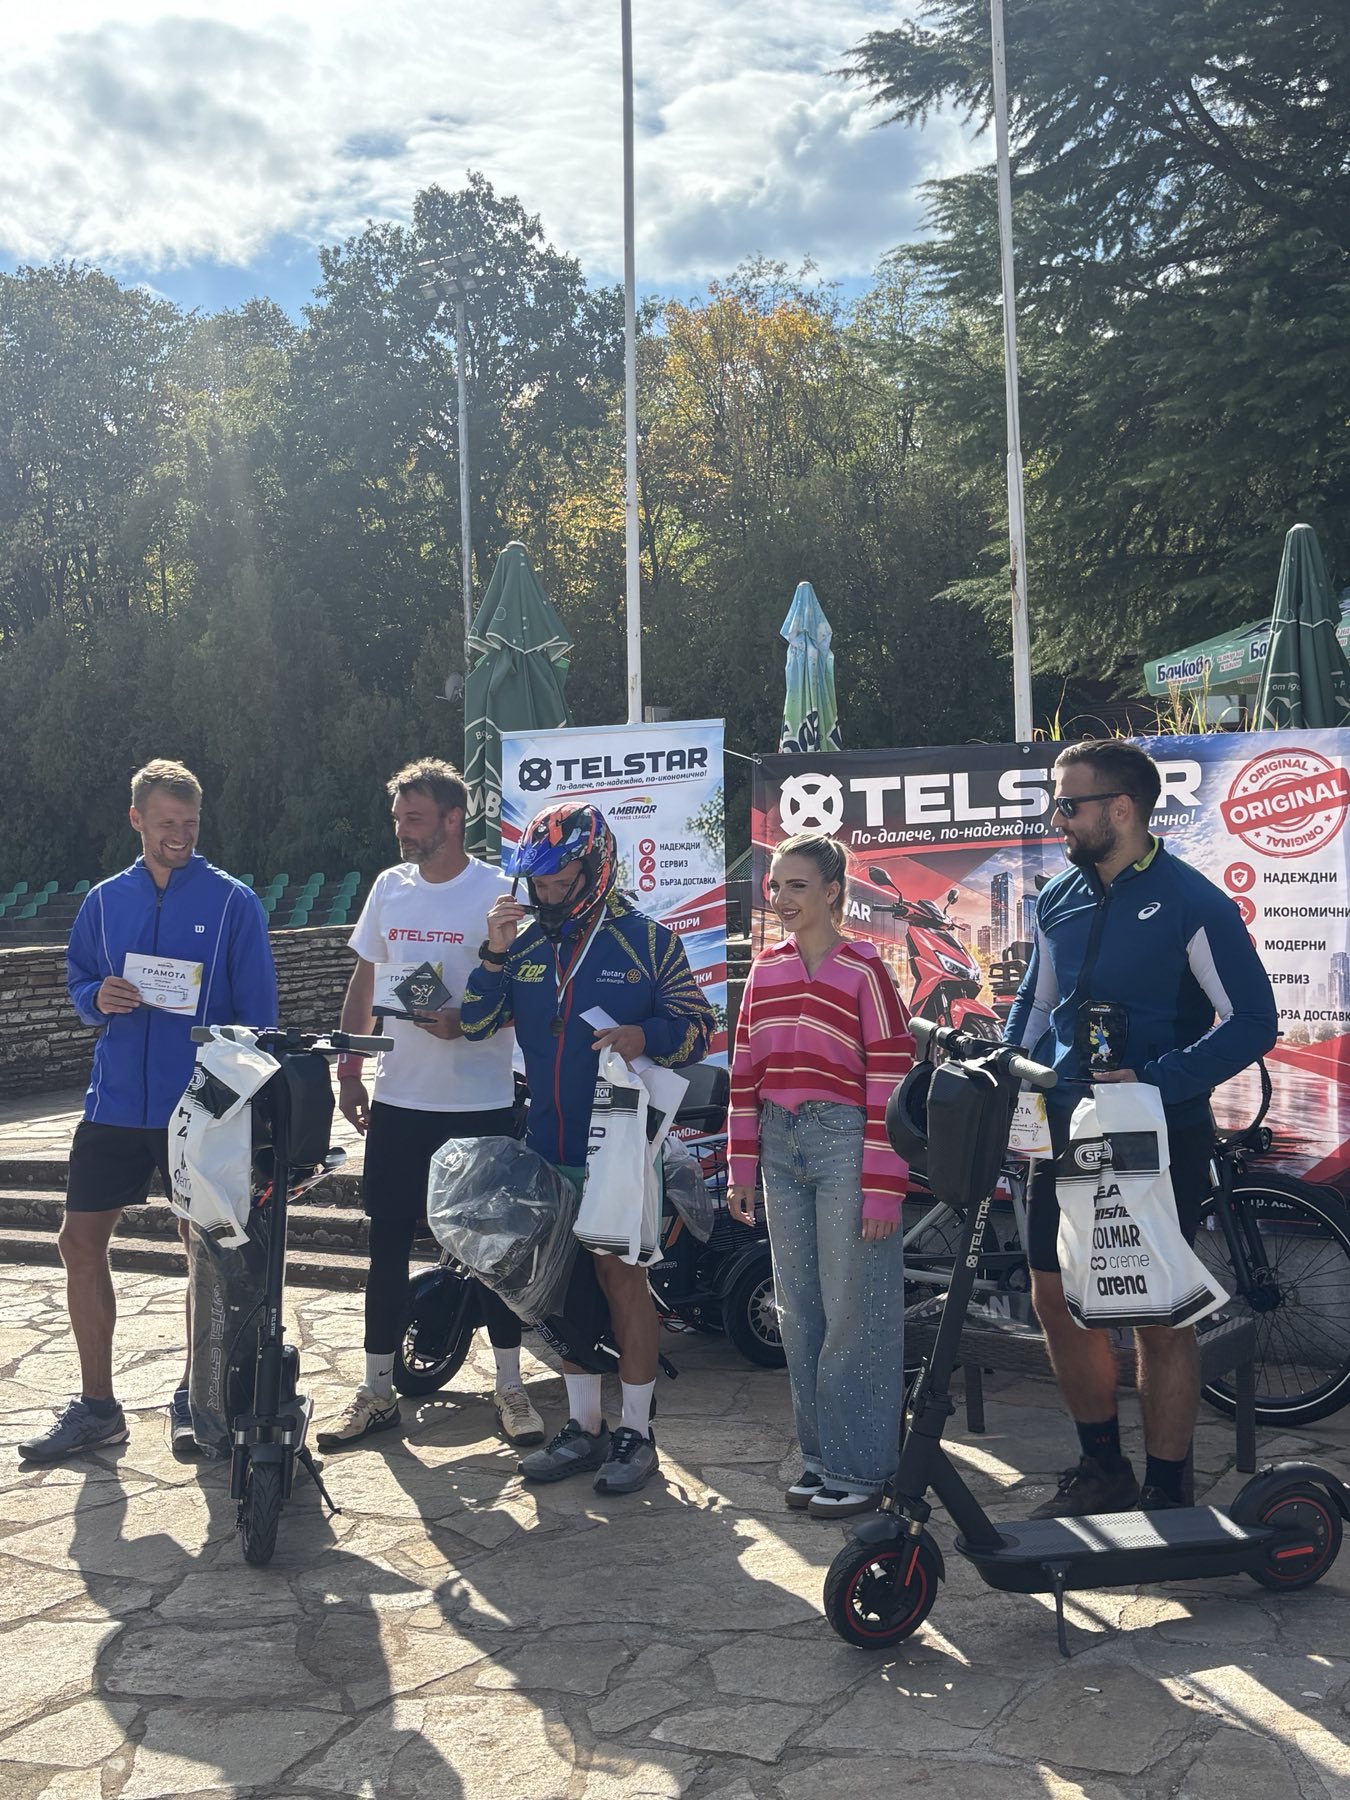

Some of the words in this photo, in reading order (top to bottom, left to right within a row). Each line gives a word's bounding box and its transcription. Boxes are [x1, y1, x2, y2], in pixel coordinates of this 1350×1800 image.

[556, 747, 708, 782] TELSTAR
[1248, 758, 1309, 784] ORIGINAL
[556, 781, 595, 792] По-далече,
[596, 776, 645, 788] по-надеждно,
[646, 769, 708, 783] по-икономично!
[1229, 779, 1348, 825] ORIGINAL
[608, 804, 657, 816] AMBINOR
[851, 828, 936, 845] По-далече,
[940, 820, 1049, 841] по-надеждно,
[1265, 825, 1324, 848] ORIGINAL
[659, 842, 701, 852] НАДЕЖДНИ
[660, 860, 689, 869] СЕРВИЗ
[660, 878, 682, 887] БЪРЗА
[683, 877, 717, 887] ДОСТАВКА
[1263, 872, 1338, 885] НАДЕЖДНИ
[666, 916, 700, 931] ОТОРИ
[398, 929, 465, 945] TELSTAR
[1264, 940, 1327, 952] МОДЕРНИ
[142, 967, 187, 980] ГРАМОТА
[516, 963, 547, 978] TOP
[601, 969, 626, 979] Rotary
[1109, 1254, 1151, 1269] creme
[1097, 1274, 1149, 1297] arena
